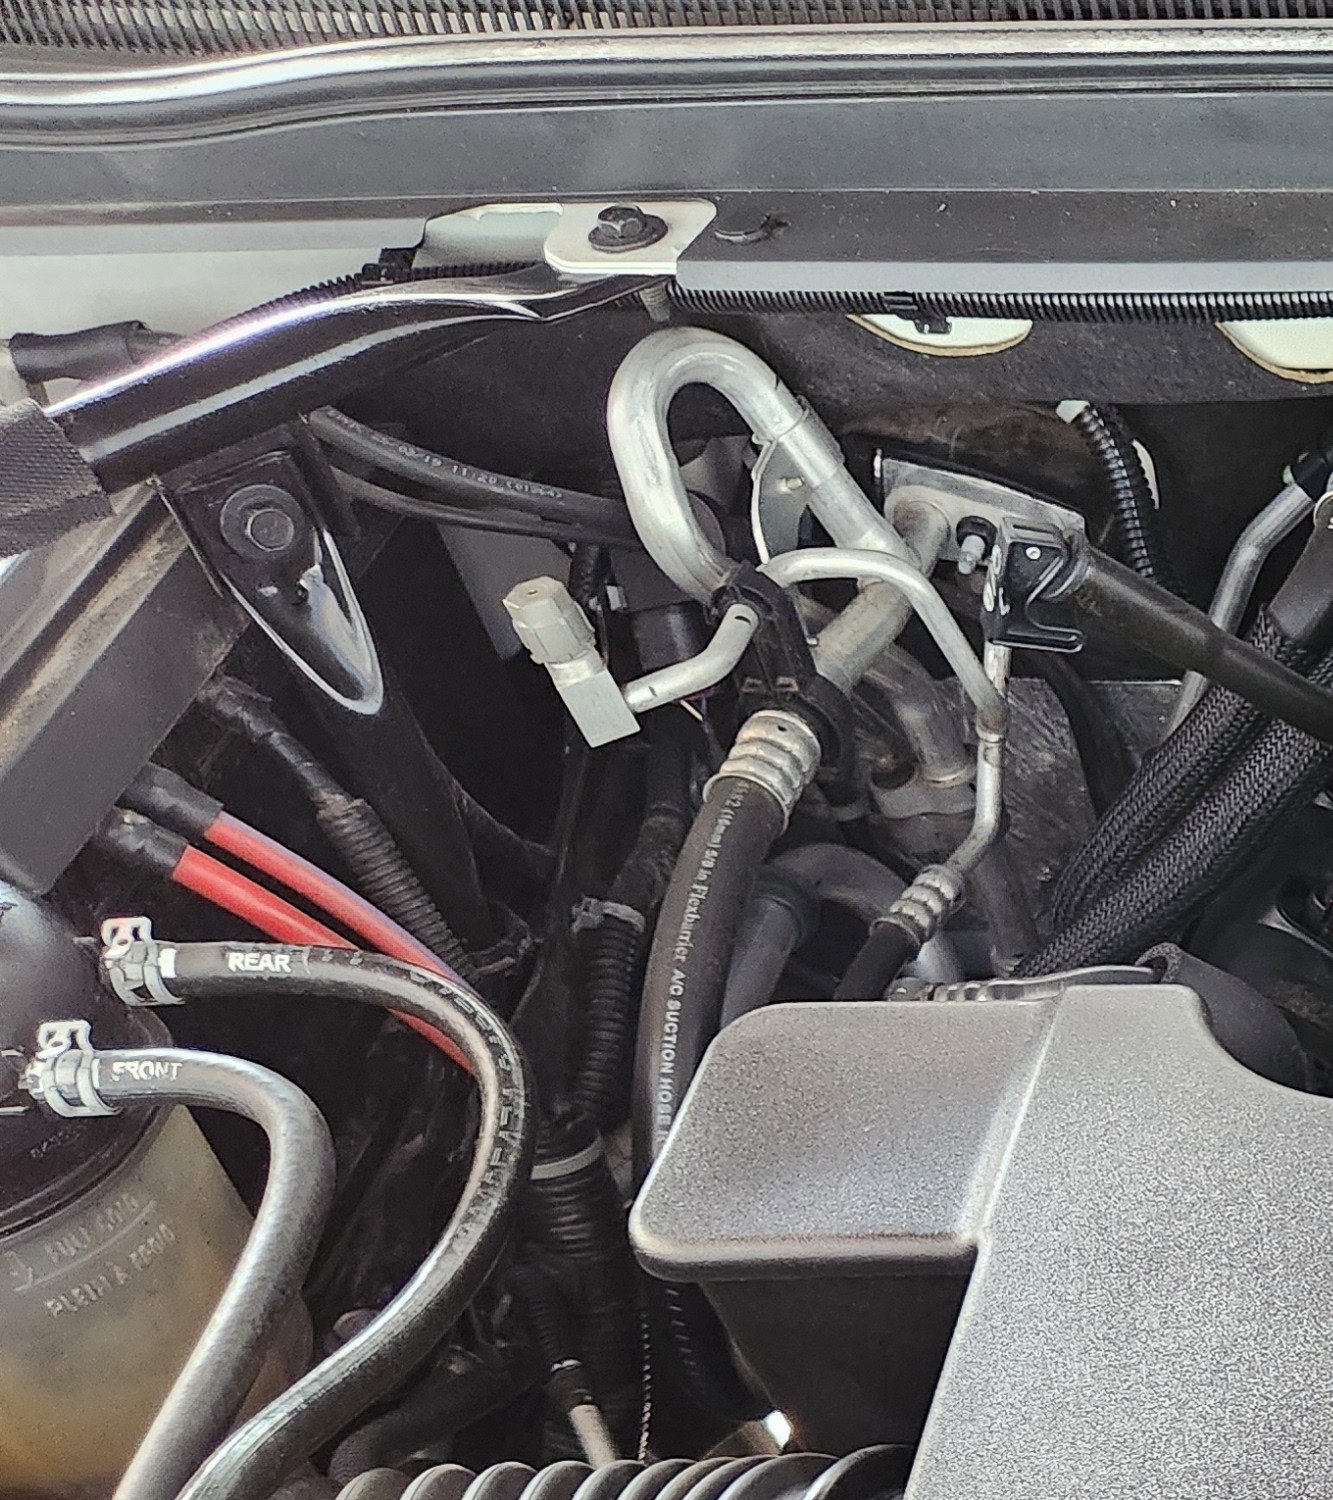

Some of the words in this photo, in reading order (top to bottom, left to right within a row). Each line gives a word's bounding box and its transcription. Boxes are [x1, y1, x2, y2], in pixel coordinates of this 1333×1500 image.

[227, 951, 292, 973] REAR
[668, 968, 688, 997] A/C
[659, 998, 683, 1074] SUCTION
[110, 1059, 183, 1083] FRONT
